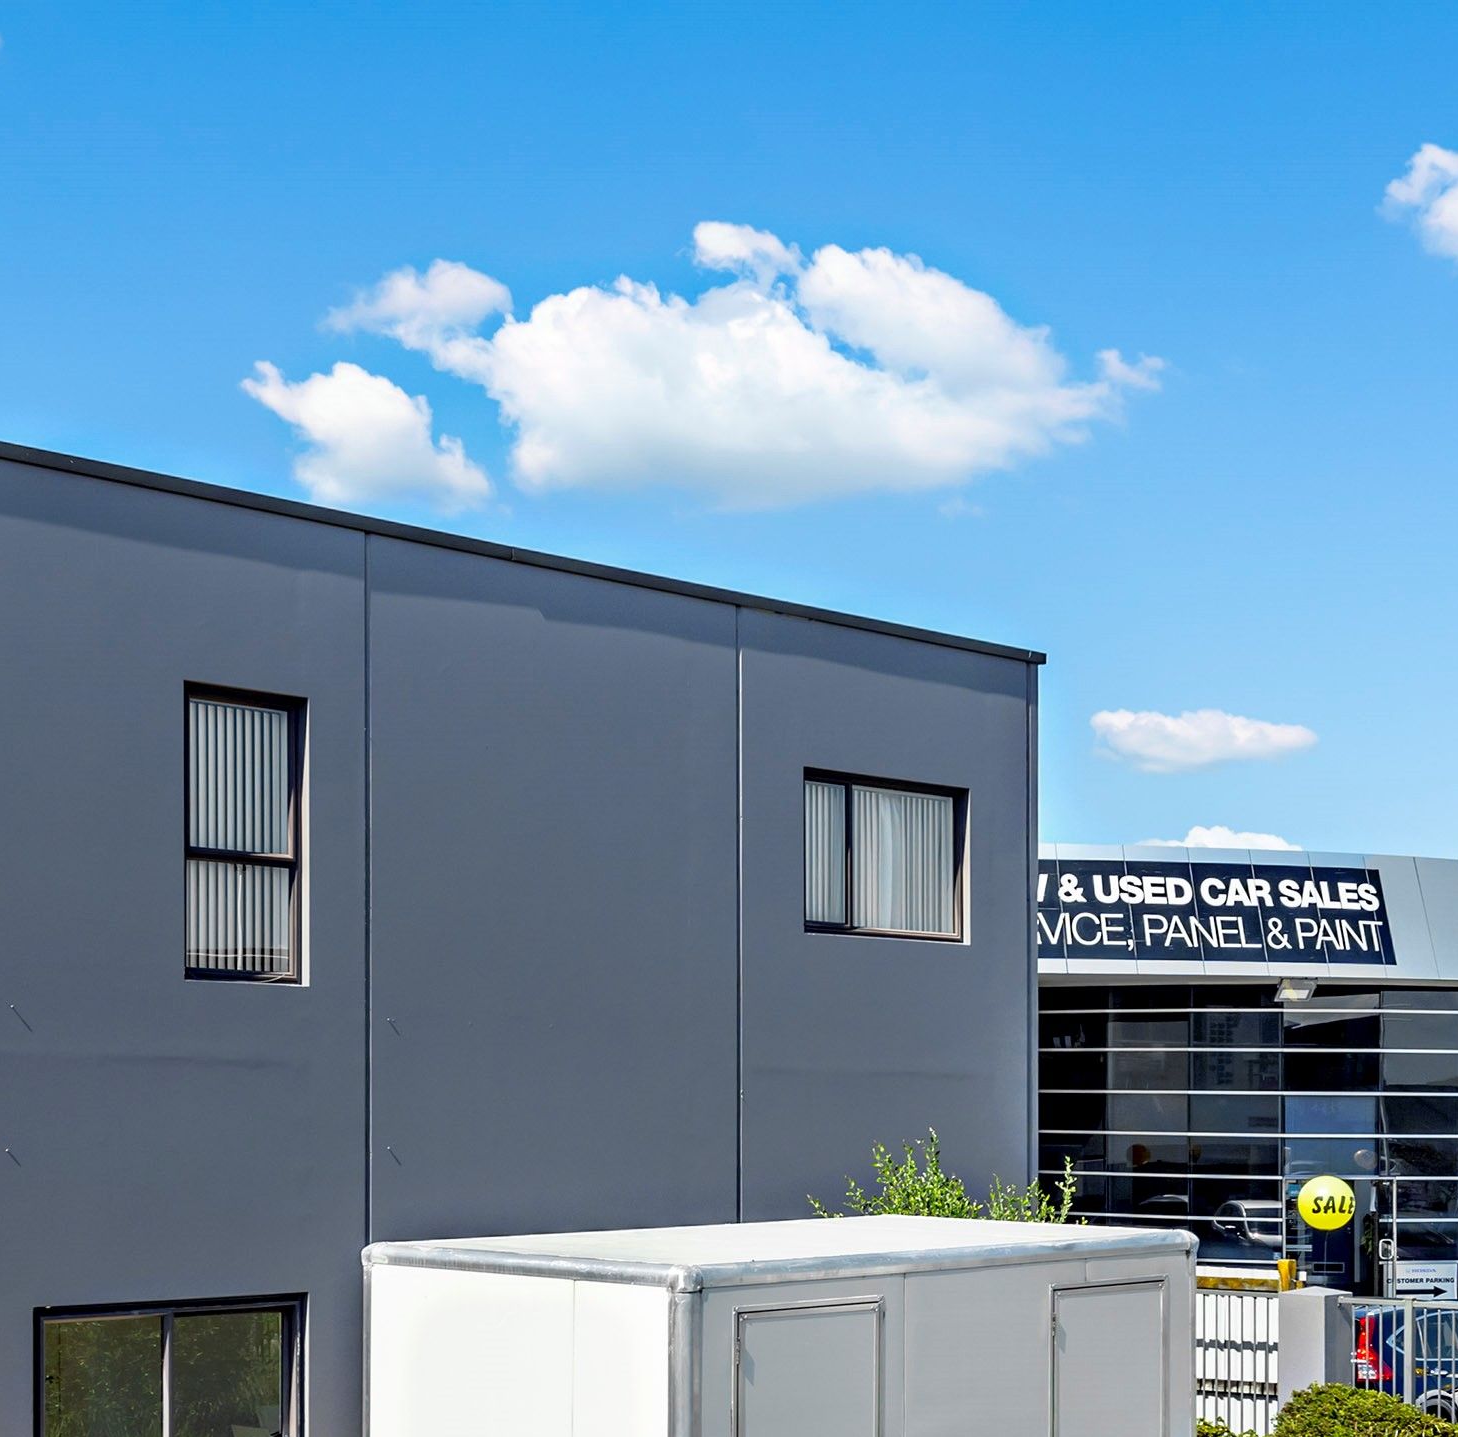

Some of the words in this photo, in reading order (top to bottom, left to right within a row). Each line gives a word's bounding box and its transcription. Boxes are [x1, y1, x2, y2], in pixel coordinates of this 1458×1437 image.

[1058, 873, 1087, 903] &
[1092, 874, 1193, 905] USED
[1199, 877, 1274, 907] CAR
[1278, 879, 1380, 912] SALES
[1143, 914, 1262, 949] PANEL
[1267, 917, 1292, 950] &
[1295, 918, 1384, 952] PAINT
